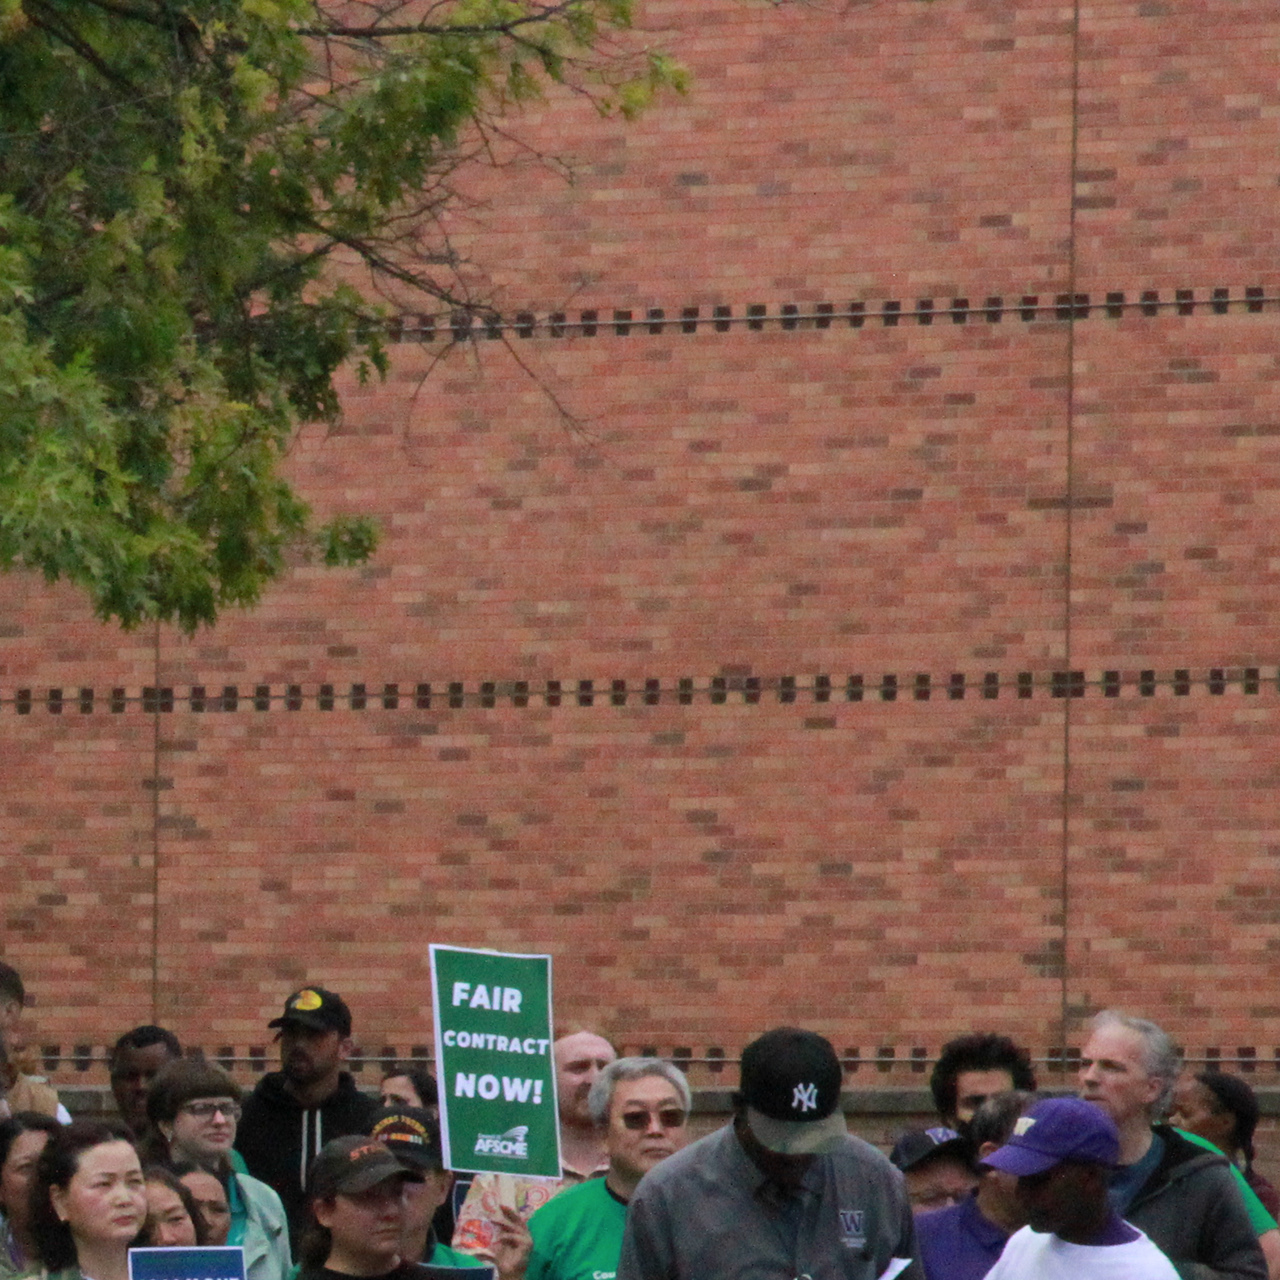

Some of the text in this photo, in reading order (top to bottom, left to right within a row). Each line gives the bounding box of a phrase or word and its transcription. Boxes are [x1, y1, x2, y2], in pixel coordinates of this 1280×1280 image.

[452, 982, 523, 1013] FAIR
[443, 1030, 549, 1055] CONTRACT
[455, 1072, 544, 1105] NOW!
[474, 1138, 528, 1156] AFSCME
[840, 1211, 863, 1233] W
